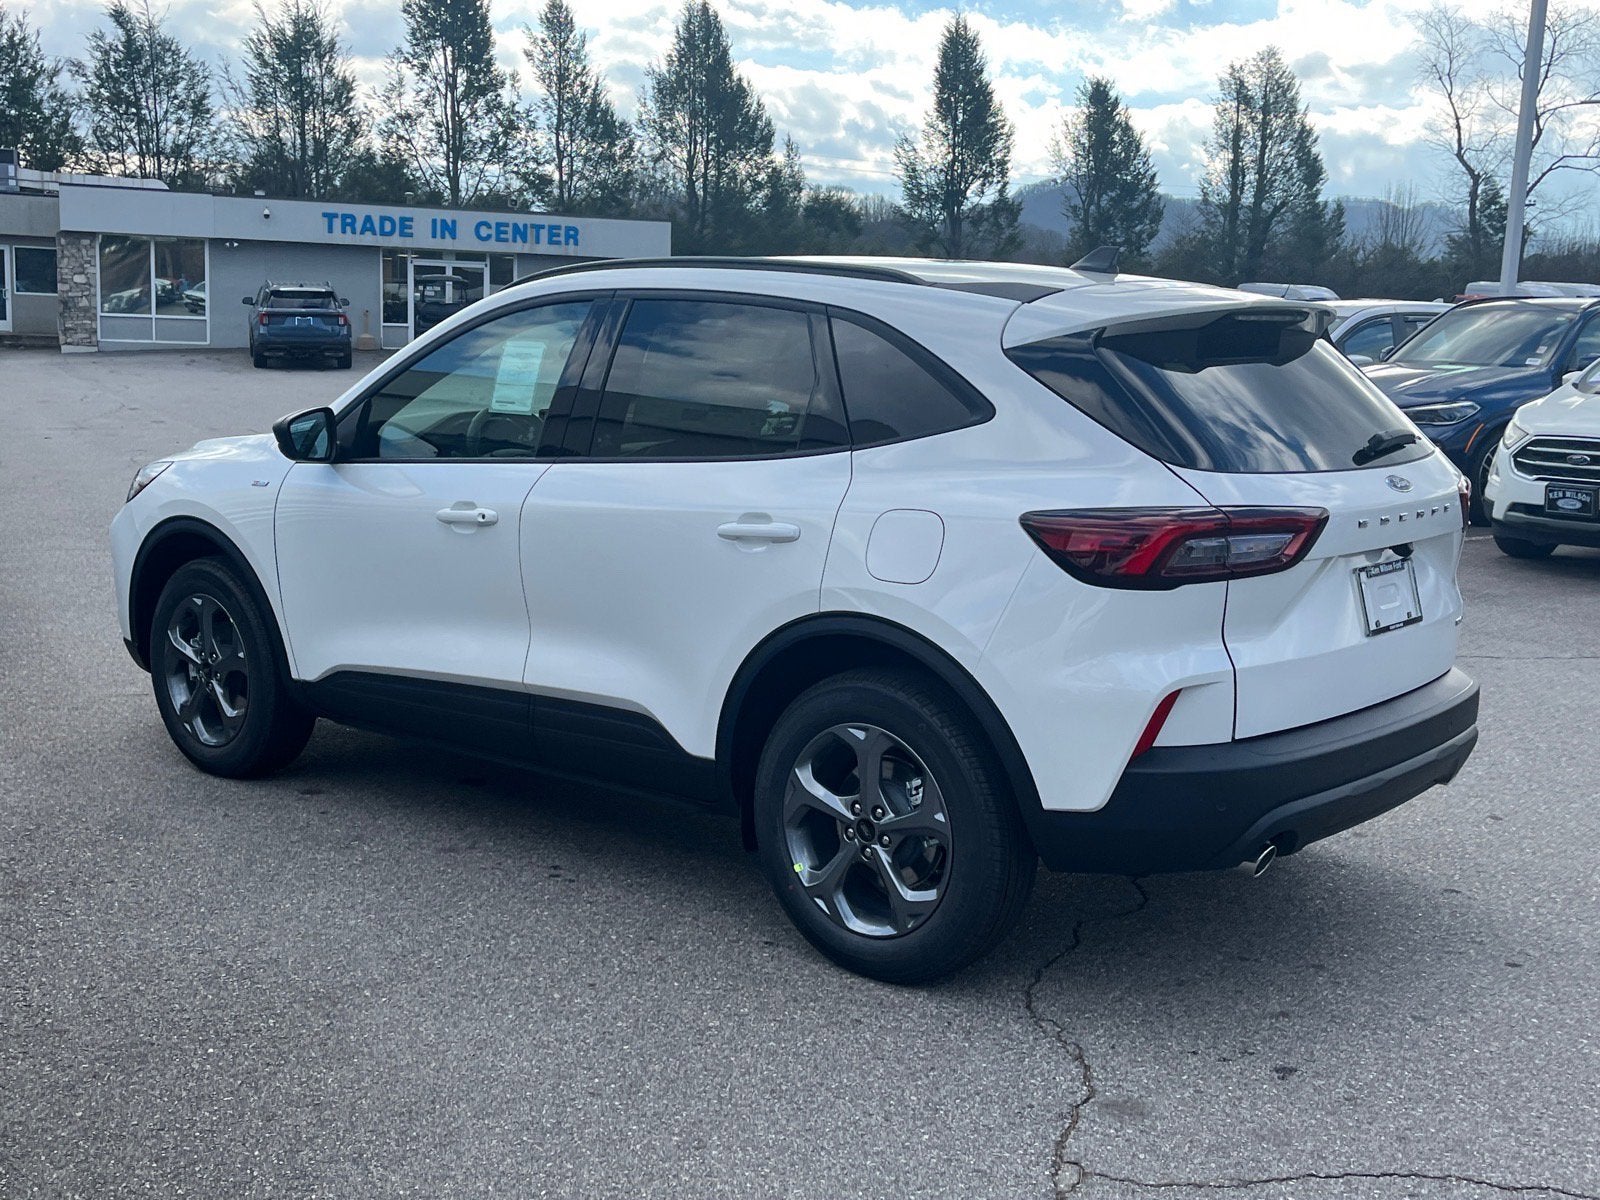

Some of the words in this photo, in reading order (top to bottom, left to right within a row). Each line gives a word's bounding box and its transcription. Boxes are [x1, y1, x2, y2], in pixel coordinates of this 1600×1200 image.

[322, 212, 414, 238] TRADE
[431, 218, 457, 240] IN
[474, 220, 579, 247] CENTER
[1549, 491, 1563, 499] KEN
[1565, 491, 1591, 503] WILSON
[1358, 503, 1450, 529] ESCAPE
